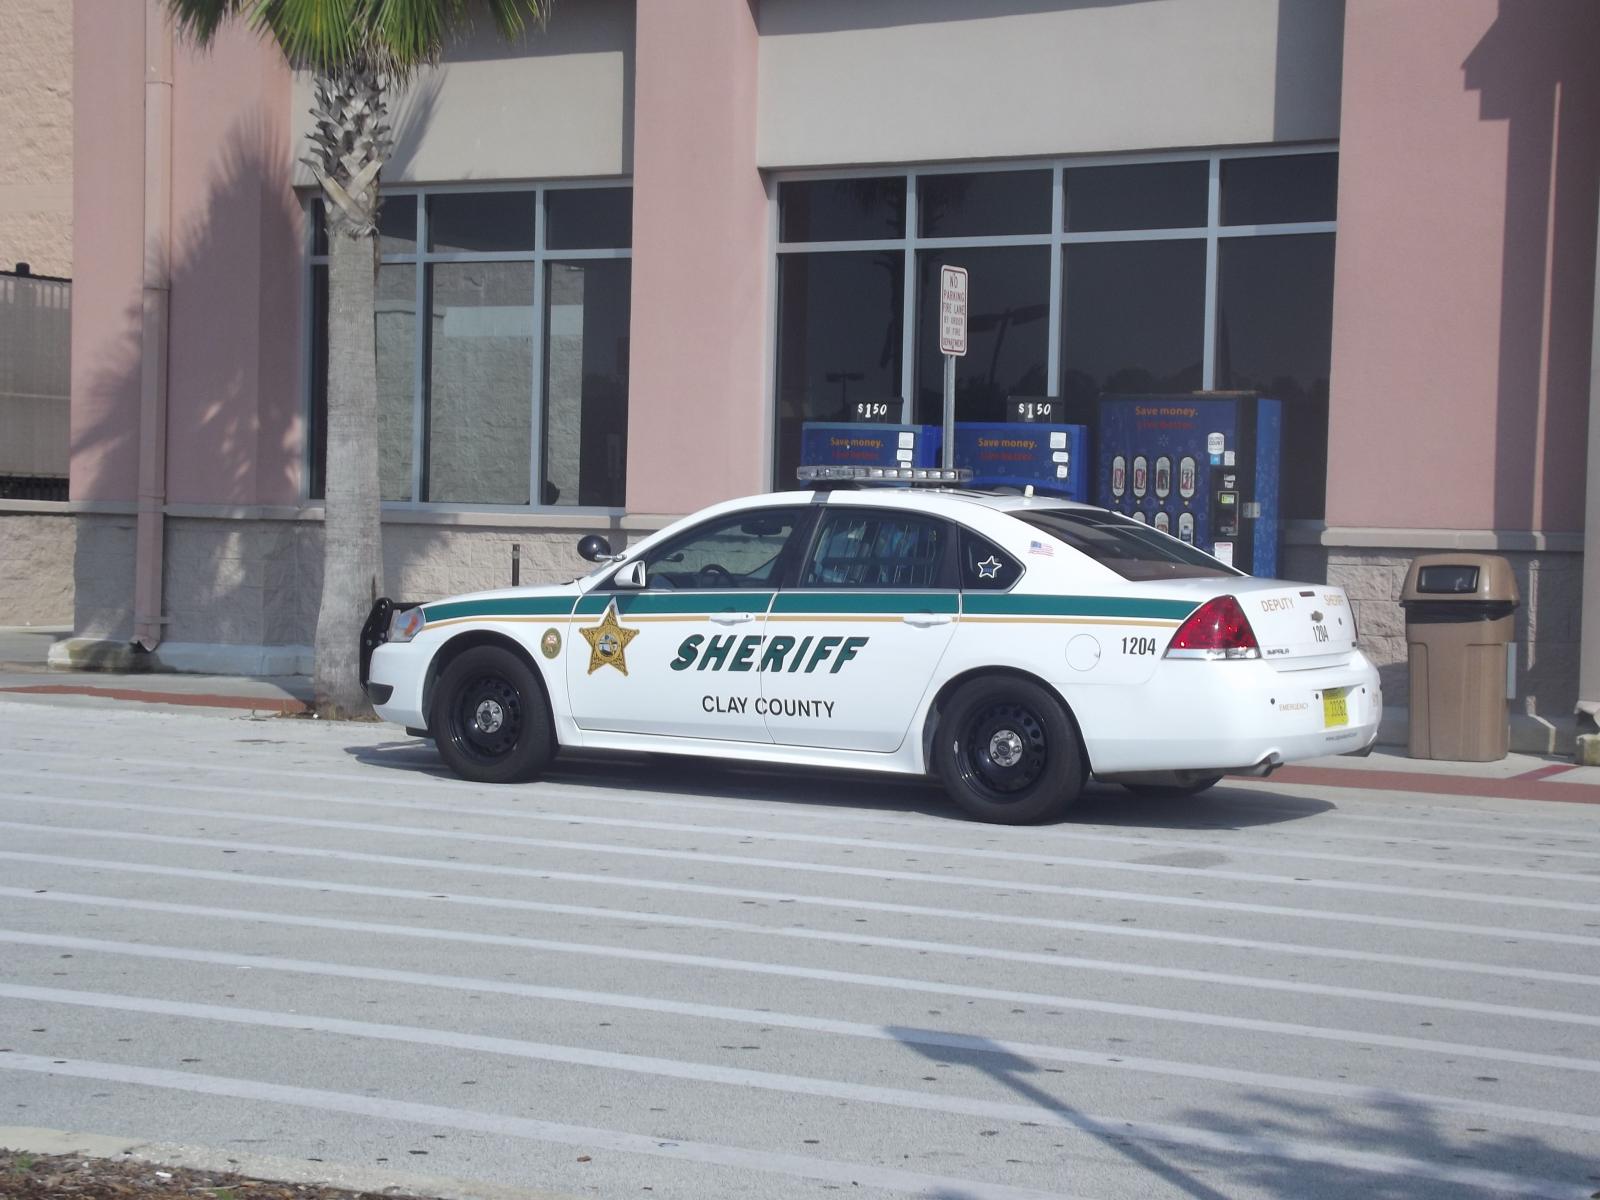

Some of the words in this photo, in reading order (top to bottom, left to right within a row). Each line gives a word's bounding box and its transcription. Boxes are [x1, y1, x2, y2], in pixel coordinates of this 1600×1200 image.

[949, 275, 958, 288] NO
[944, 290, 964, 302] PARKING
[943, 303, 952, 314] FIRE
[953, 304, 965, 315] LANE
[951, 317, 963, 326] ORDER
[952, 328, 961, 337] FIRE
[943, 338, 963, 347] DEPARTMENT
[1135, 406, 1158, 416] Save
[1160, 407, 1199, 418] money.
[831, 437, 850, 446] Save
[978, 438, 1000, 447] Save
[1002, 438, 1037, 449] money.
[1261, 597, 1296, 612] DEPUTY
[1312, 624, 1330, 643] 1204
[1121, 636, 1156, 656] 1204
[669, 633, 870, 674] SHERIFF
[702, 695, 748, 714] CLAY
[755, 697, 835, 718] COUNTY
[1279, 703, 1309, 712] EMERGENCY
